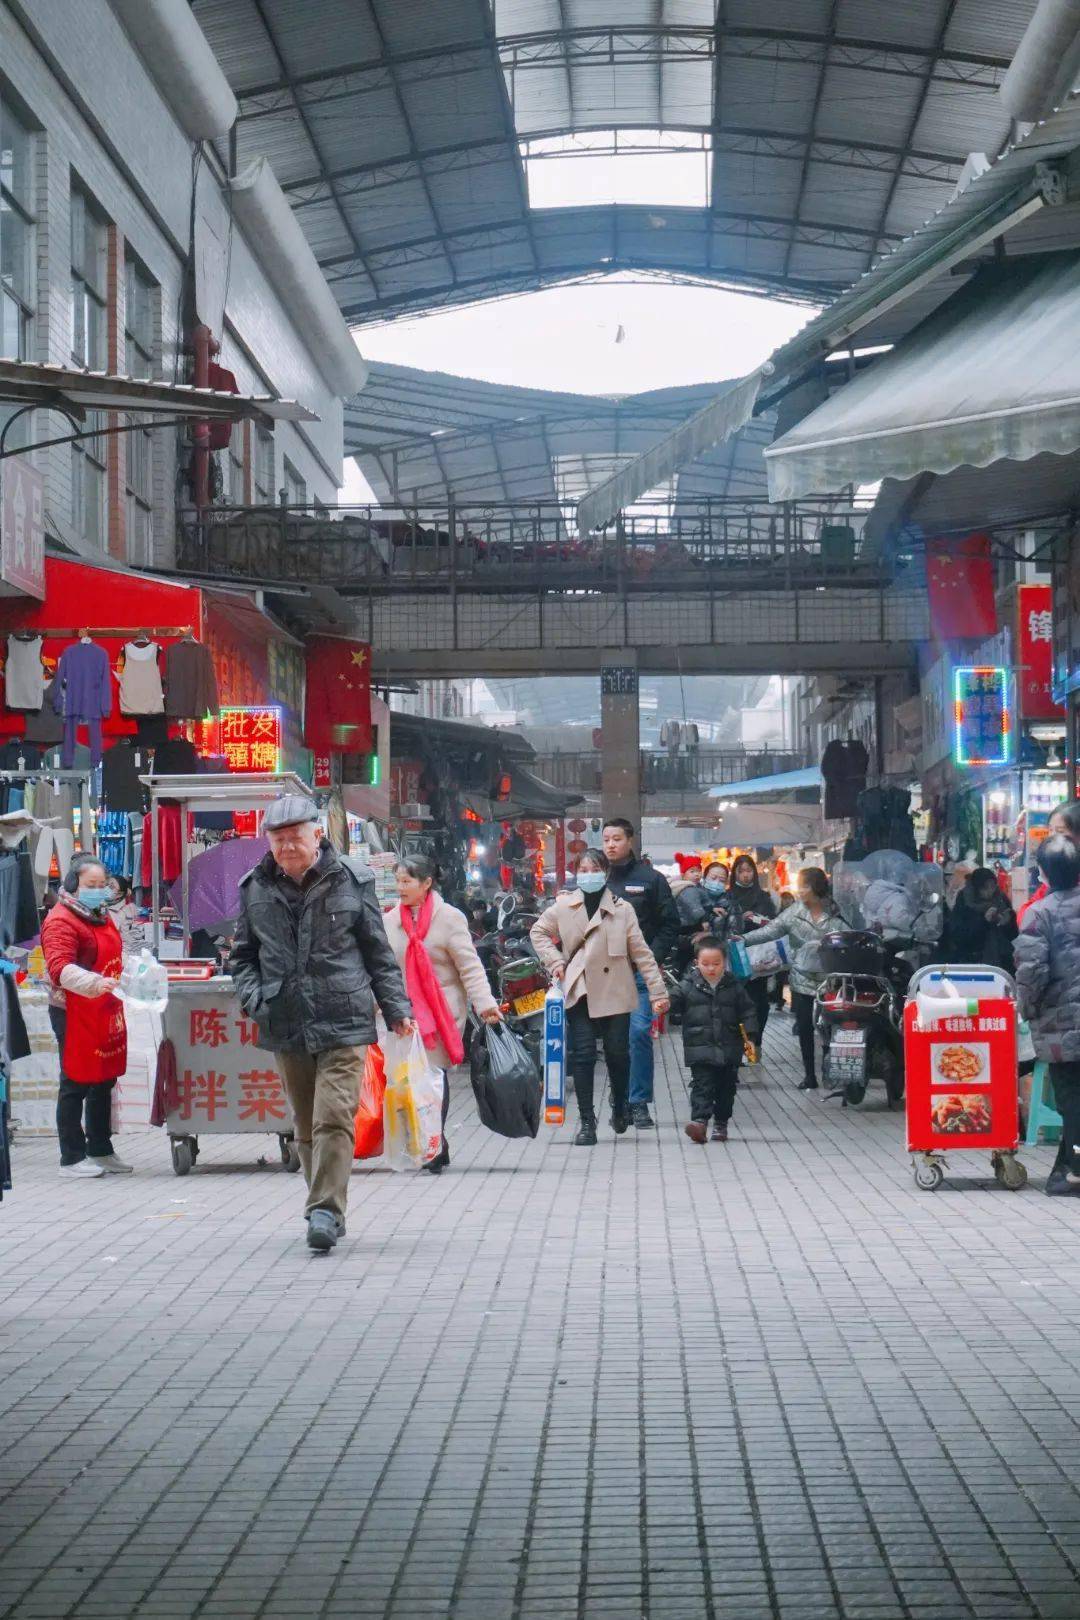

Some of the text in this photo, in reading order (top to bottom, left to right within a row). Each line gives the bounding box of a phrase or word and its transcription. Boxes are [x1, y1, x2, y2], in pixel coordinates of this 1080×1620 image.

[223, 711, 275, 738] 批发
[316, 757, 330, 767] 29
[316, 769, 330, 778] 34
[177, 1069, 287, 1122] 拌菜
